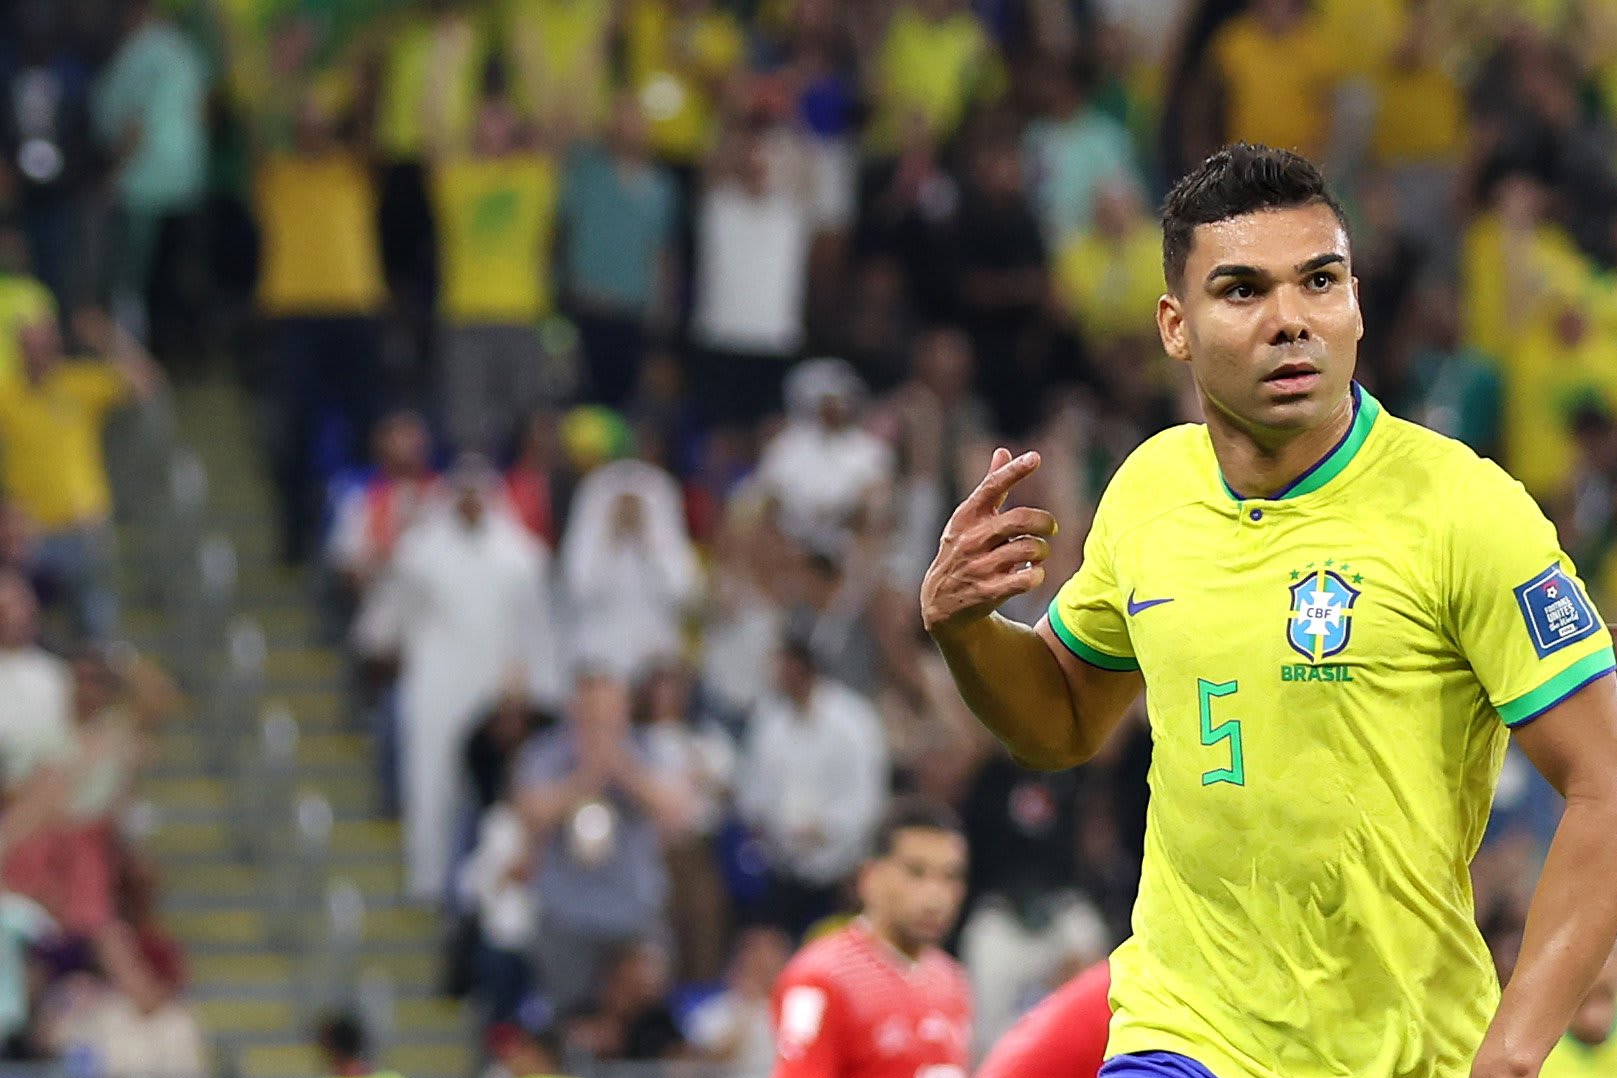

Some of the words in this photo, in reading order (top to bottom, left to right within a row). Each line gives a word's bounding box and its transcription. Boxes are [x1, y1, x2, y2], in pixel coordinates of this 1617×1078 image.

[1306, 607, 1333, 619] CBF
[1281, 665, 1354, 682] BRASIL
[1197, 677, 1245, 787] 5
